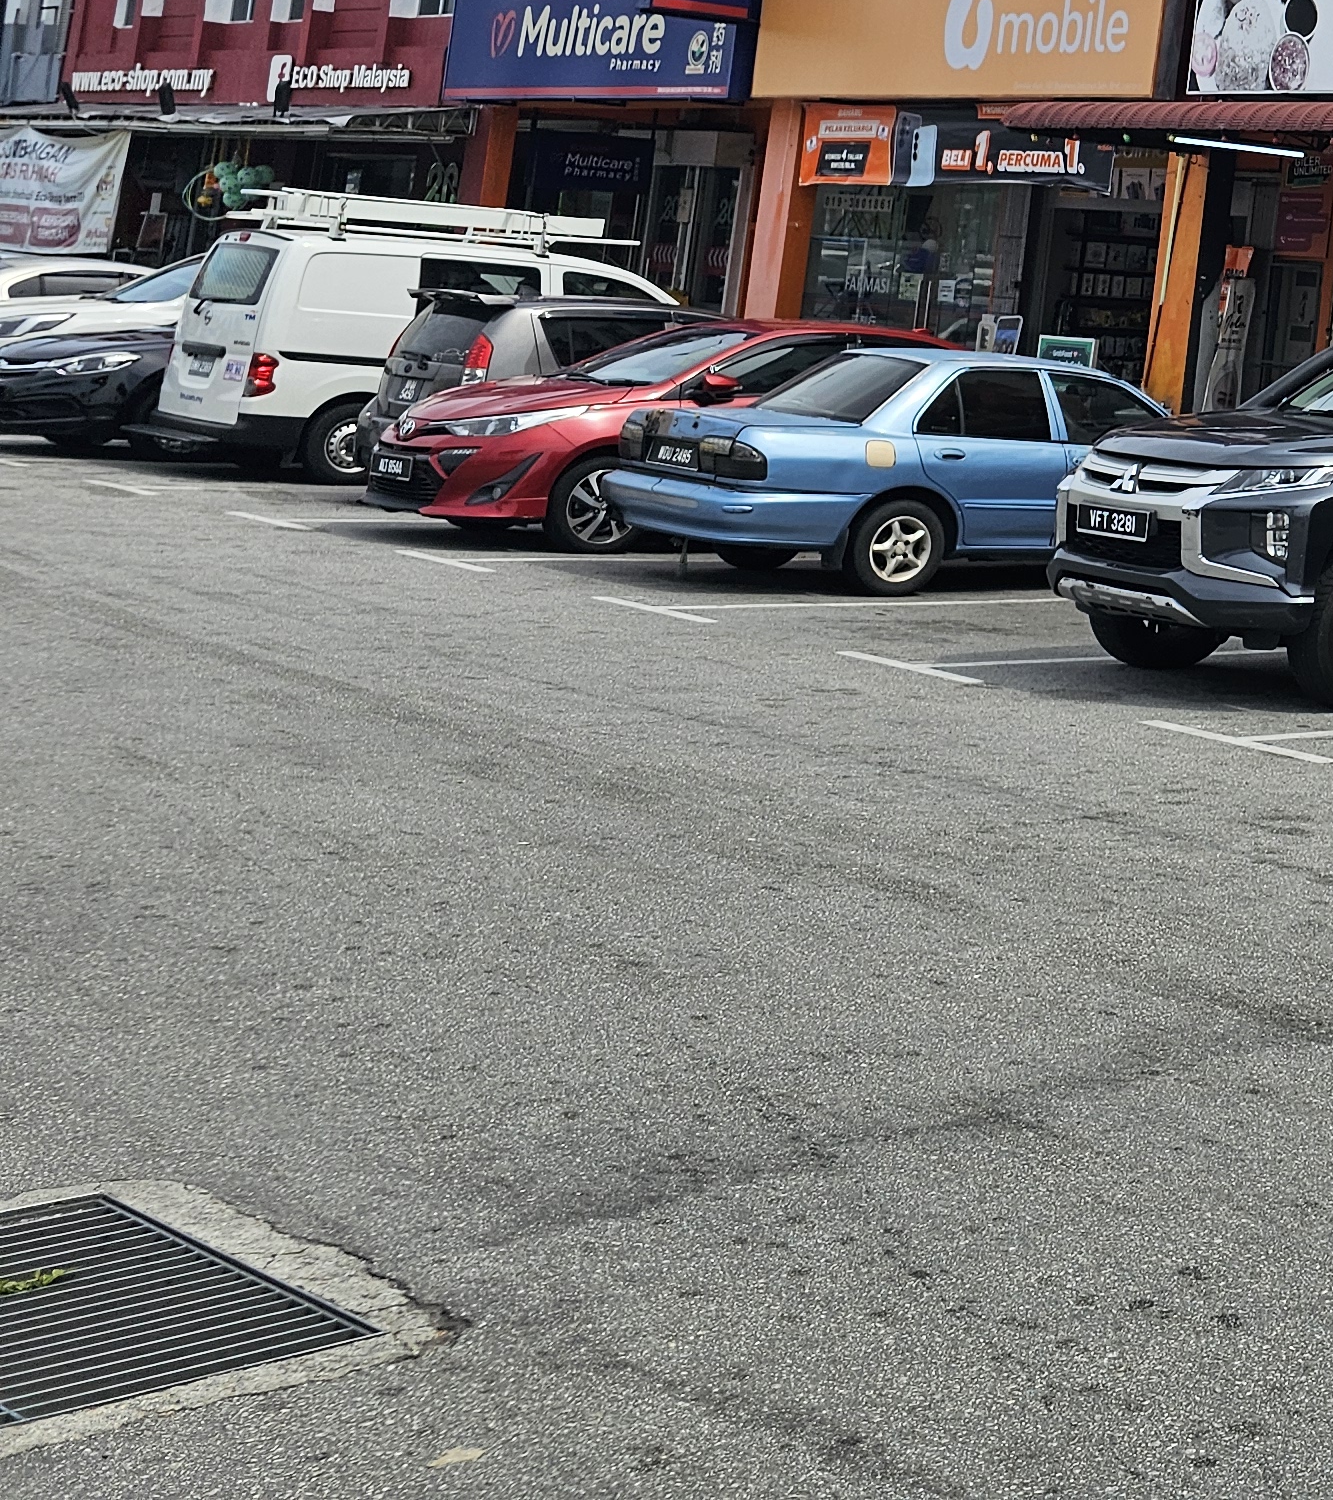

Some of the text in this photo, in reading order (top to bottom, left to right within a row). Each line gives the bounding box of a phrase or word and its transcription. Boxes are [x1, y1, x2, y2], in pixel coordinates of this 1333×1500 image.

[517, 6, 666, 58] Multicare
[609, 57, 661, 73] Pharmacy
[71, 62, 214, 97] www.eco-shop.com.my
[290, 64, 411, 93] ECO Shop Malaysia
[565, 153, 633, 170] Multicare
[942, 149, 972, 170] BELI
[997, 149, 1065, 173] PERCUMA
[564, 166, 631, 182] Pharmacy
[1293, 165, 1333, 176] UNLIMITED
[845, 276, 890, 293] FARMASI
[245, 313, 256, 321] TM
[1089, 509, 1136, 535] VFT 3281
